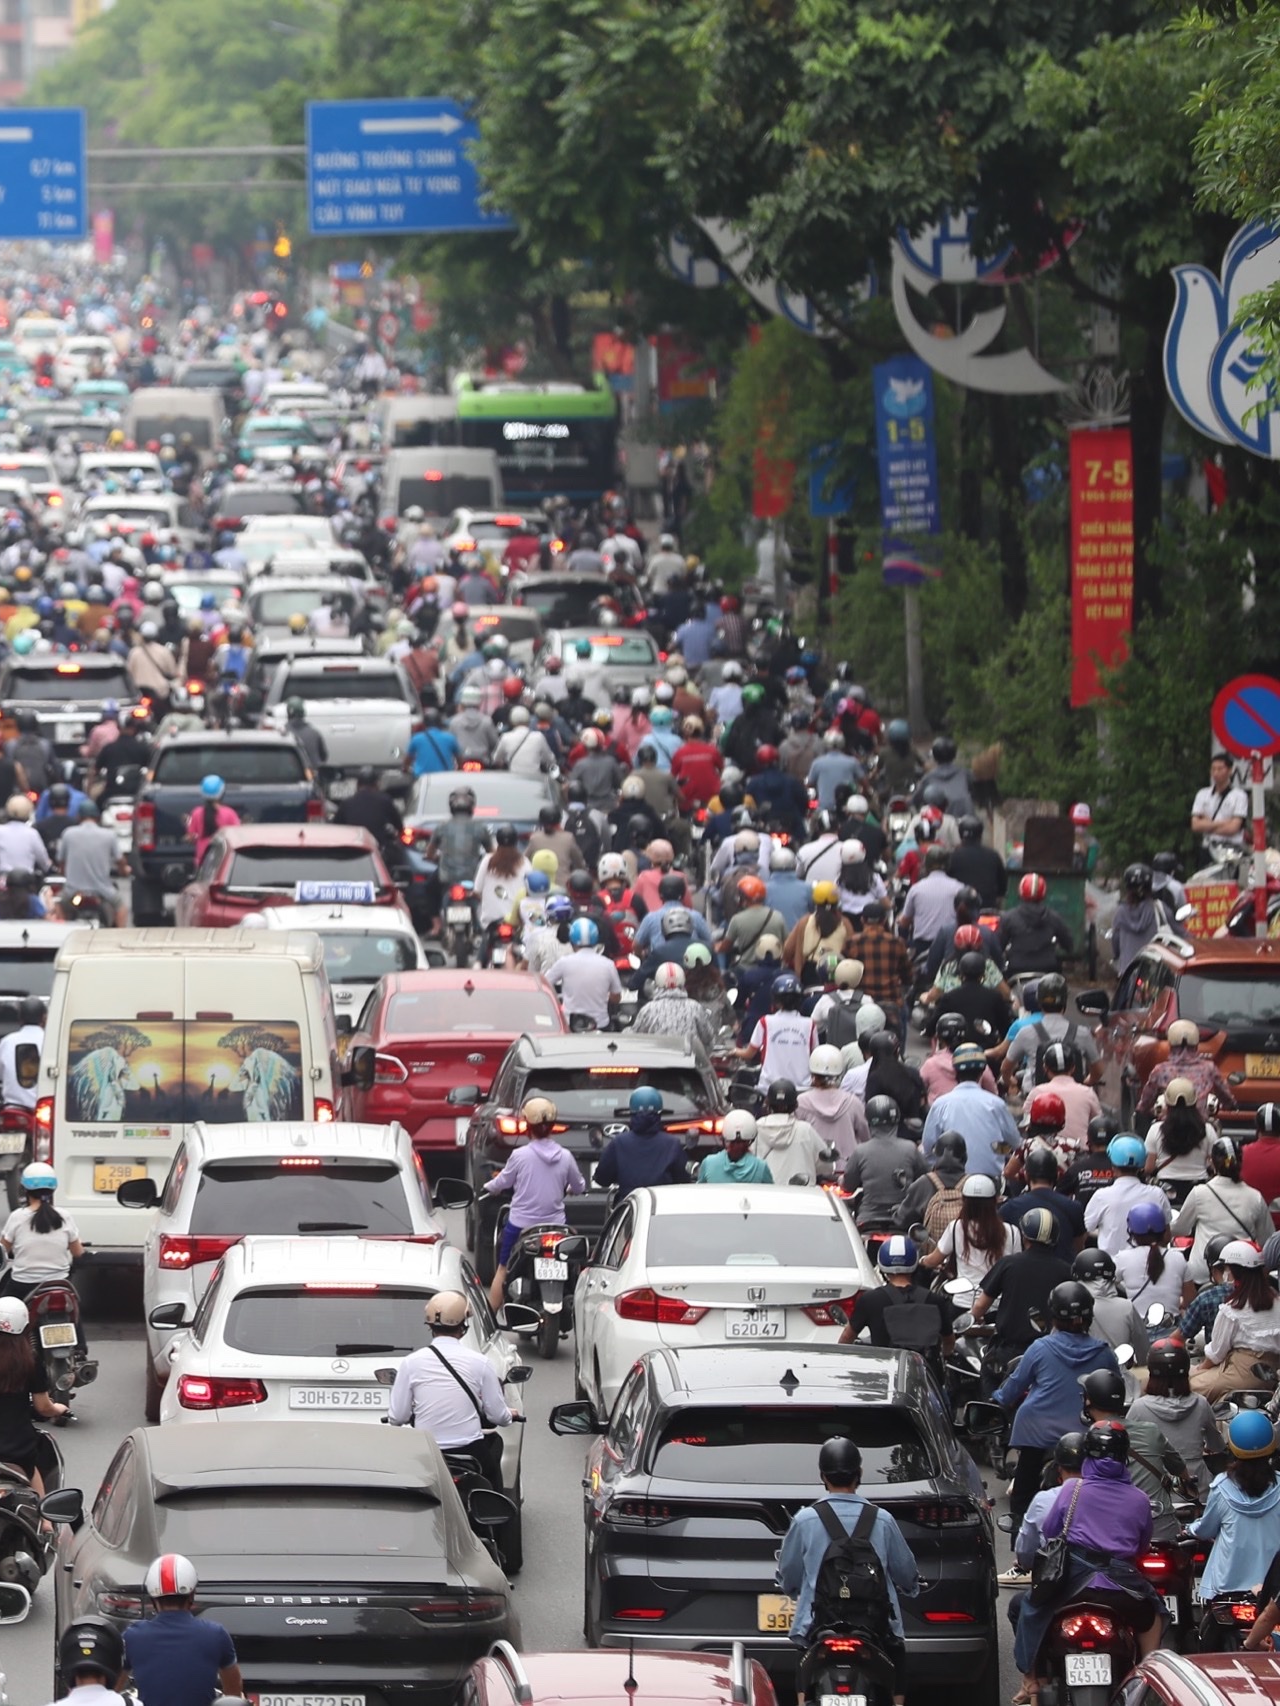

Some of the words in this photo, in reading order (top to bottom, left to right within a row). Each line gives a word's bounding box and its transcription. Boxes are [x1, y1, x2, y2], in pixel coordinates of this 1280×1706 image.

[1085, 460, 1130, 487] 7-5
[109, 1166, 132, 1178] 29B
[743, 1310, 768, 1322] 30H
[732, 1323, 779, 1336] 620.47
[298, 1391, 381, 1405] 30H-672.85
[285, 1616, 328, 1626] Cayenne
[1073, 1657, 1104, 1669] 29-T1
[1070, 1670, 1108, 1684] 545.12
